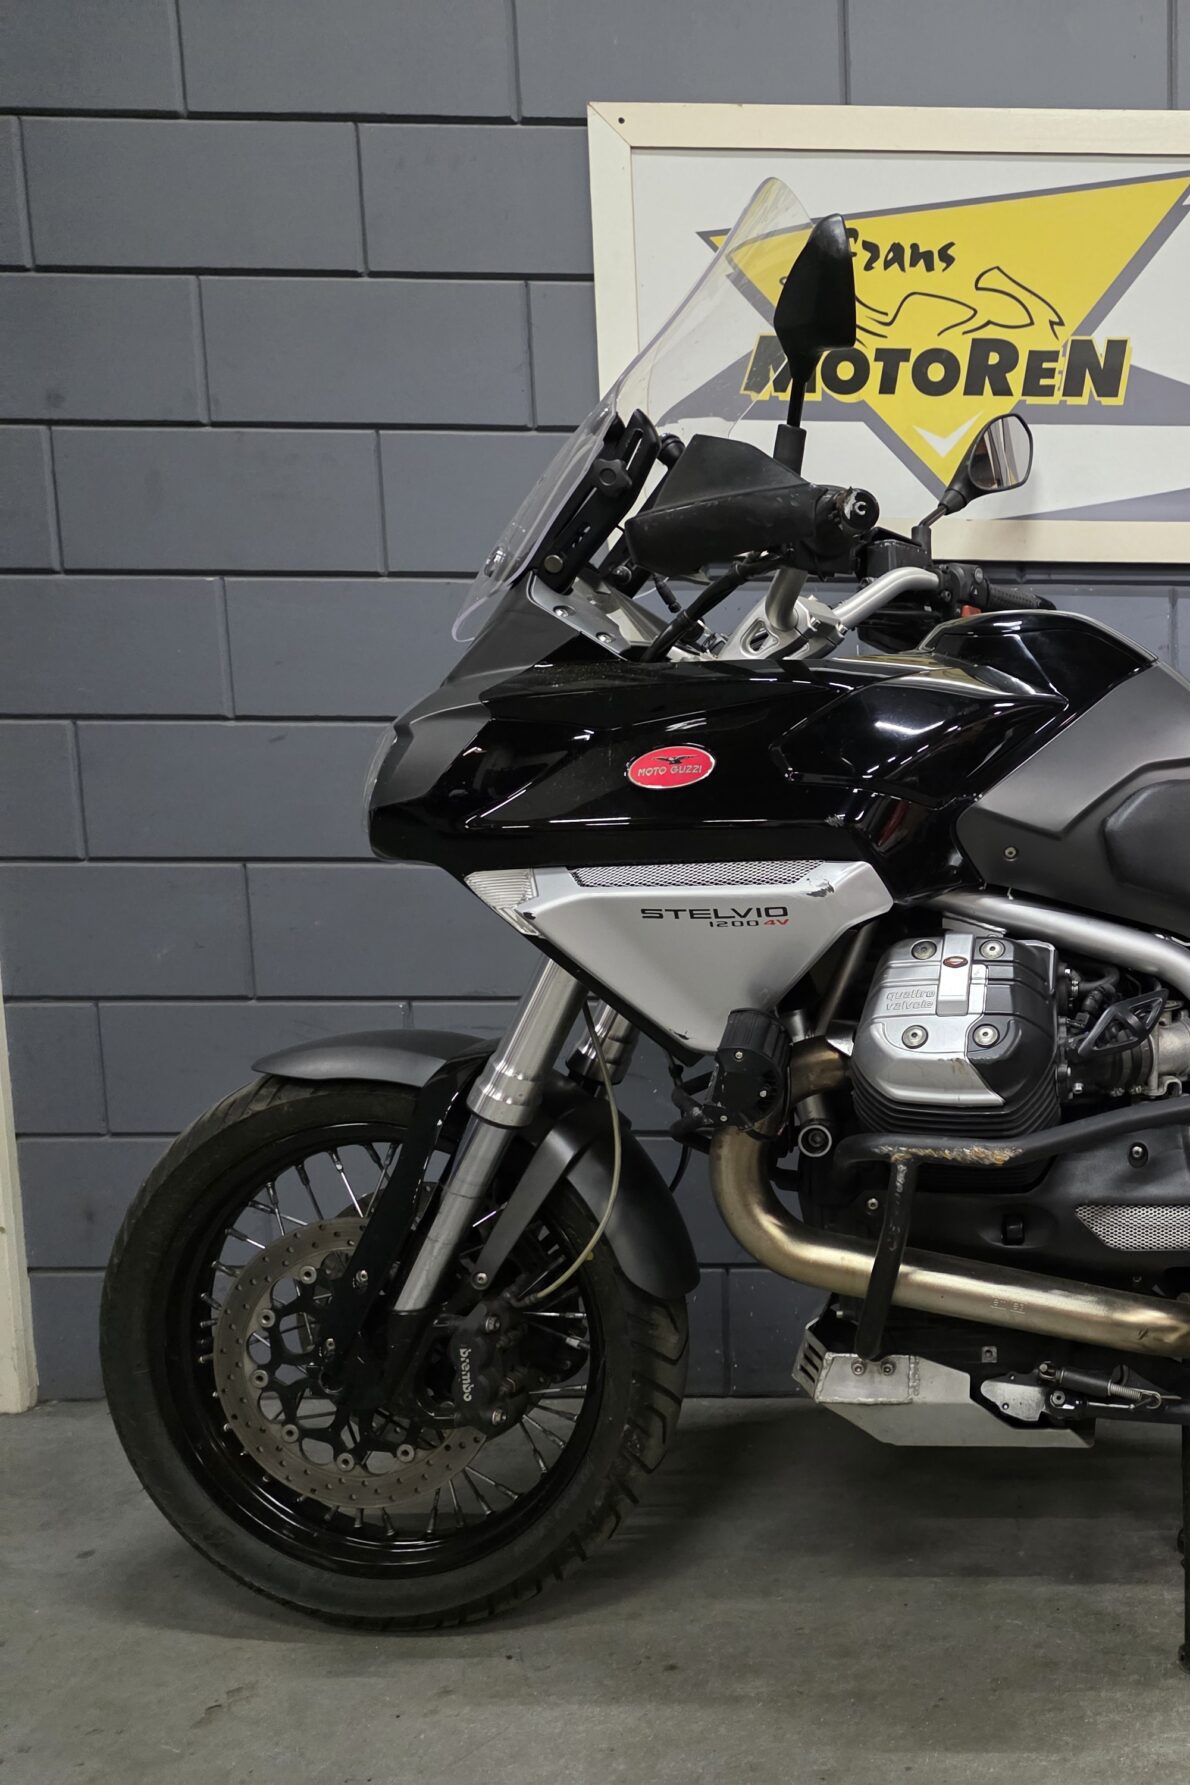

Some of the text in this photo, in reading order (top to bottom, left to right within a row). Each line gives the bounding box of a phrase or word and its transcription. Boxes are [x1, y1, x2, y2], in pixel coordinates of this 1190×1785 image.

[637, 764, 703, 777] MOTO GUZZI
[640, 906, 789, 920] STELVIO
[459, 1347, 475, 1402] brembo
